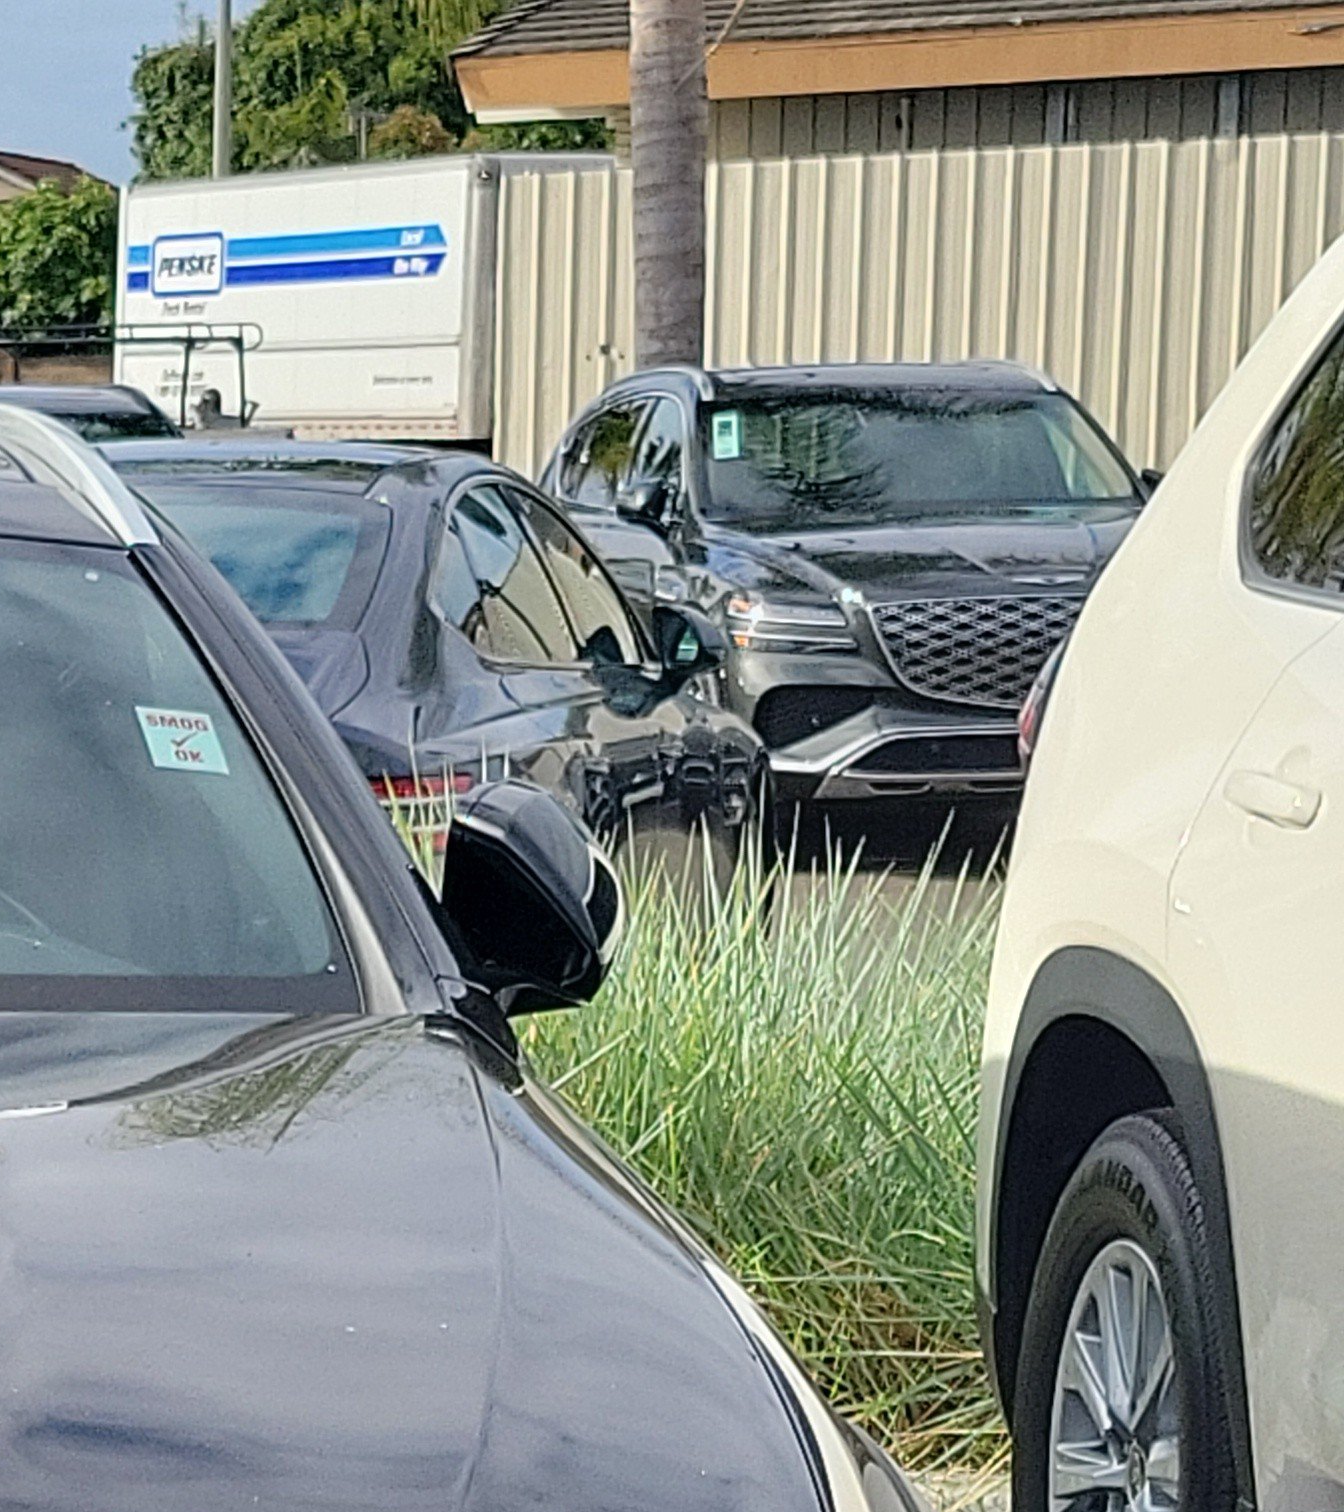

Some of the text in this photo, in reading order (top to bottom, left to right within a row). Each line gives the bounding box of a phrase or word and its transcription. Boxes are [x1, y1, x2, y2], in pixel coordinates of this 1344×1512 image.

[157, 254, 217, 277] PENSKE
[145, 714, 210, 732] SMOG
[174, 749, 204, 763] OK
